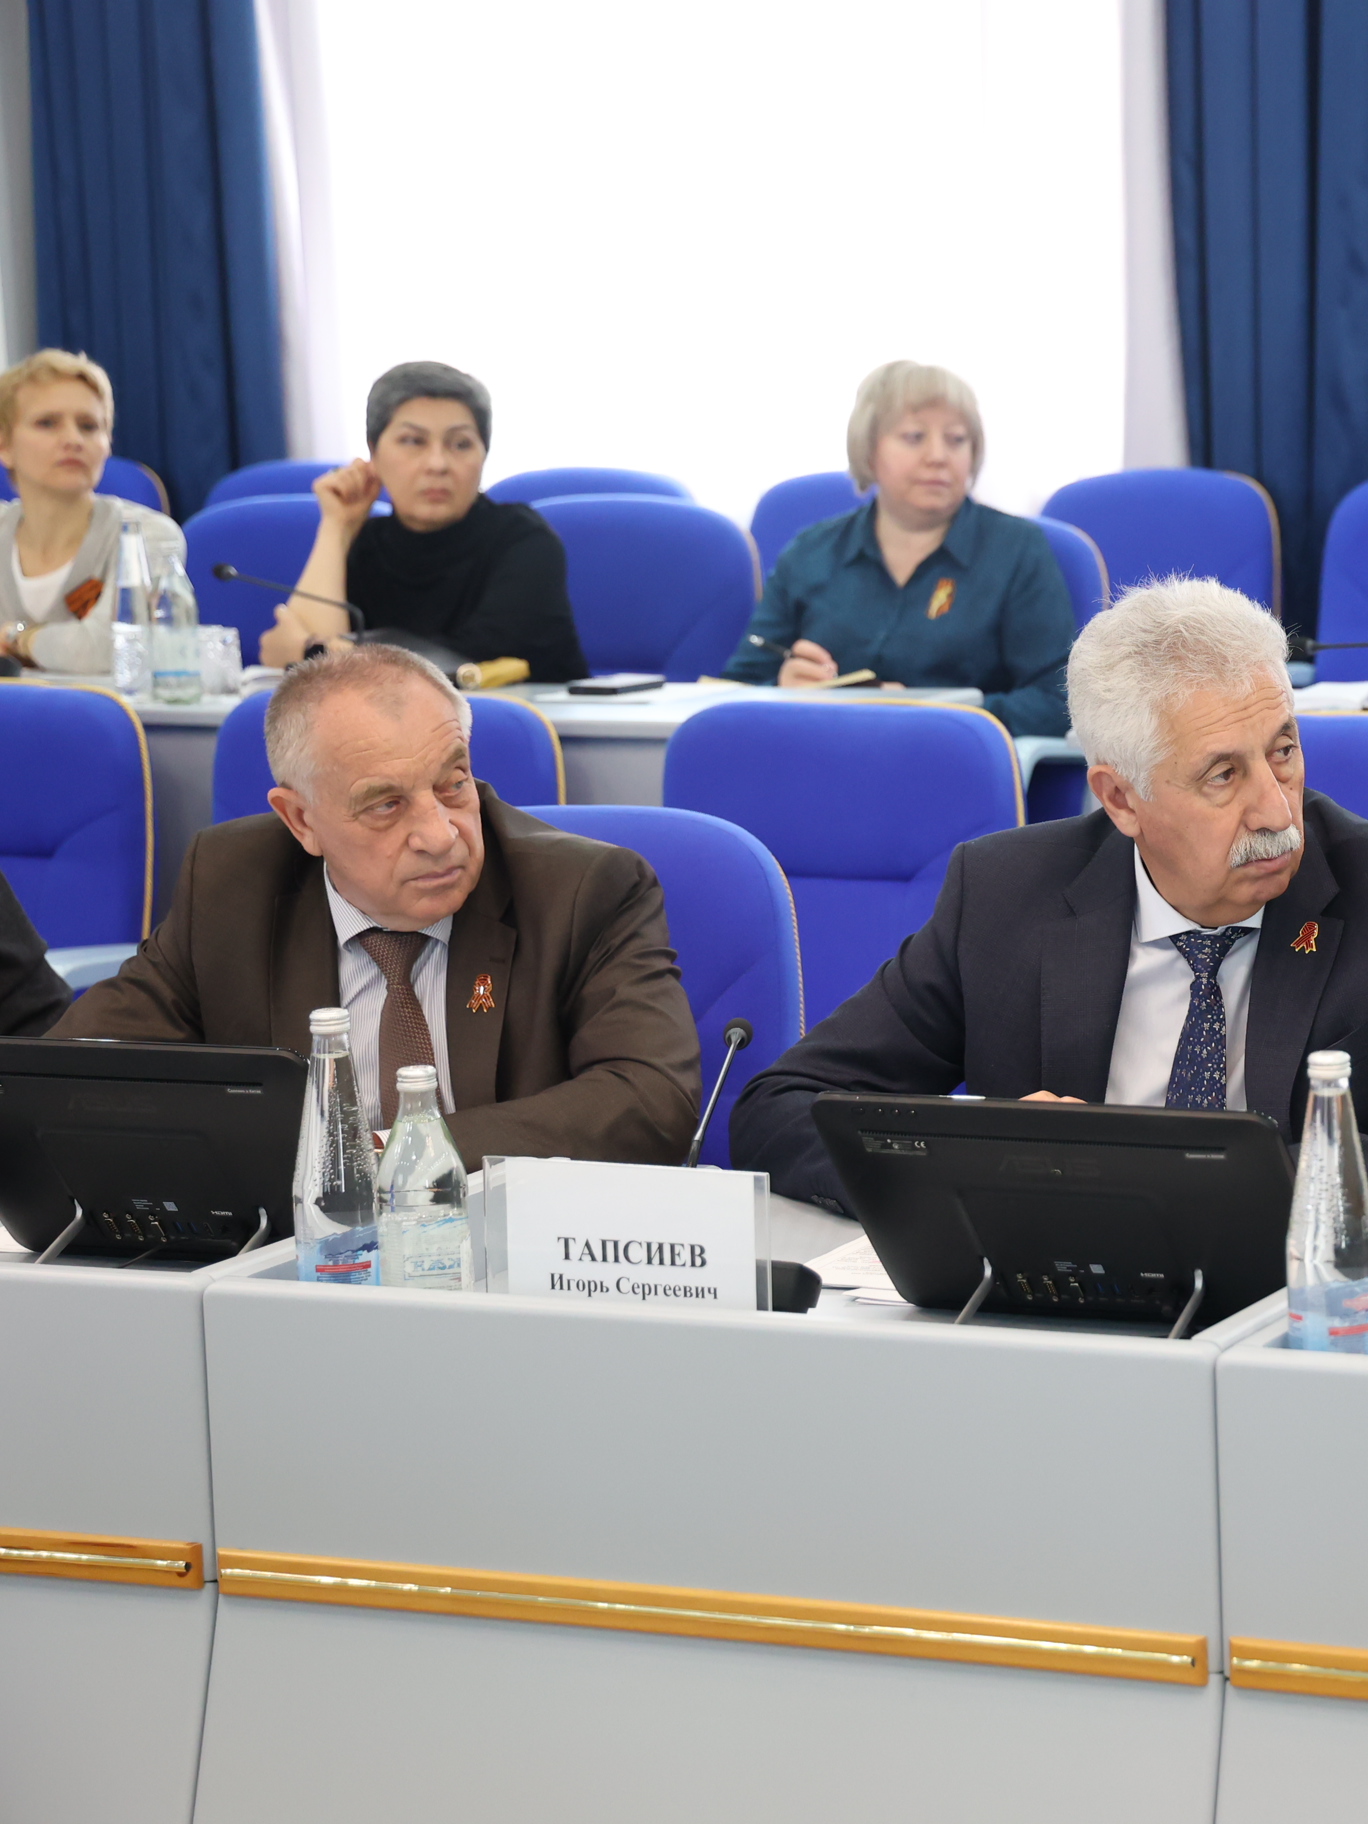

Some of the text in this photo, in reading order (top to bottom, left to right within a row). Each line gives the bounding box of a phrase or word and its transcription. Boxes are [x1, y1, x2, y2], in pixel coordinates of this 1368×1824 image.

[556, 1236, 708, 1269] ТАПСИЕВ
[549, 1273, 718, 1301] Игорь Сергеевич
